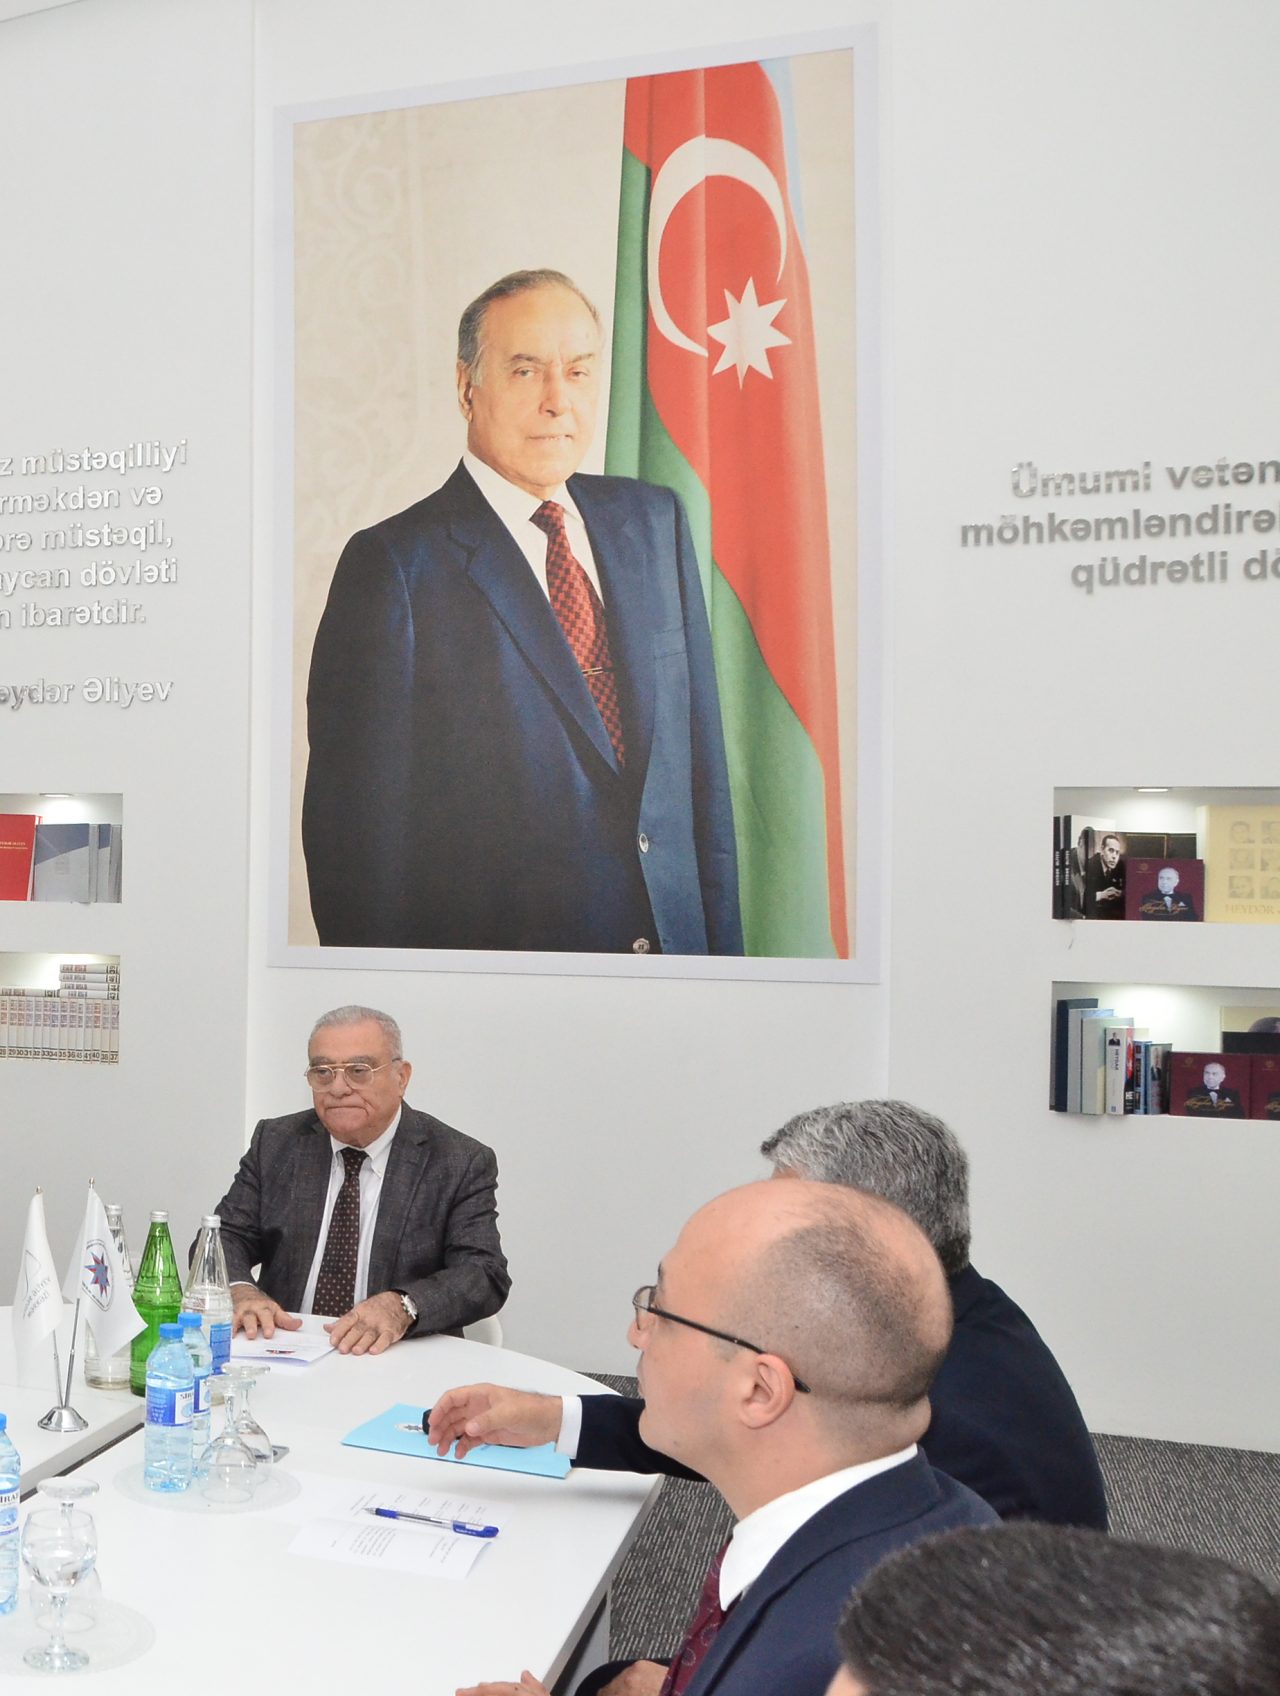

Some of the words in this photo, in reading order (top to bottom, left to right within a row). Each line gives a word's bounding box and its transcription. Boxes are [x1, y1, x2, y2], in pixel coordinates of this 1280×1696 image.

[20, 439, 188, 476] müstəqilliyi
[130, 484, 163, 507] və
[1010, 461, 1152, 497] Ümumi
[40, 519, 173, 552] müstəqil,
[960, 503, 1280, 548] möhkəmləndirə
[80, 557, 178, 589] dövləti
[1070, 551, 1228, 595] qüdrətli
[20, 599, 146, 629] ibarətdir.
[82, 676, 174, 708] Əliyev
